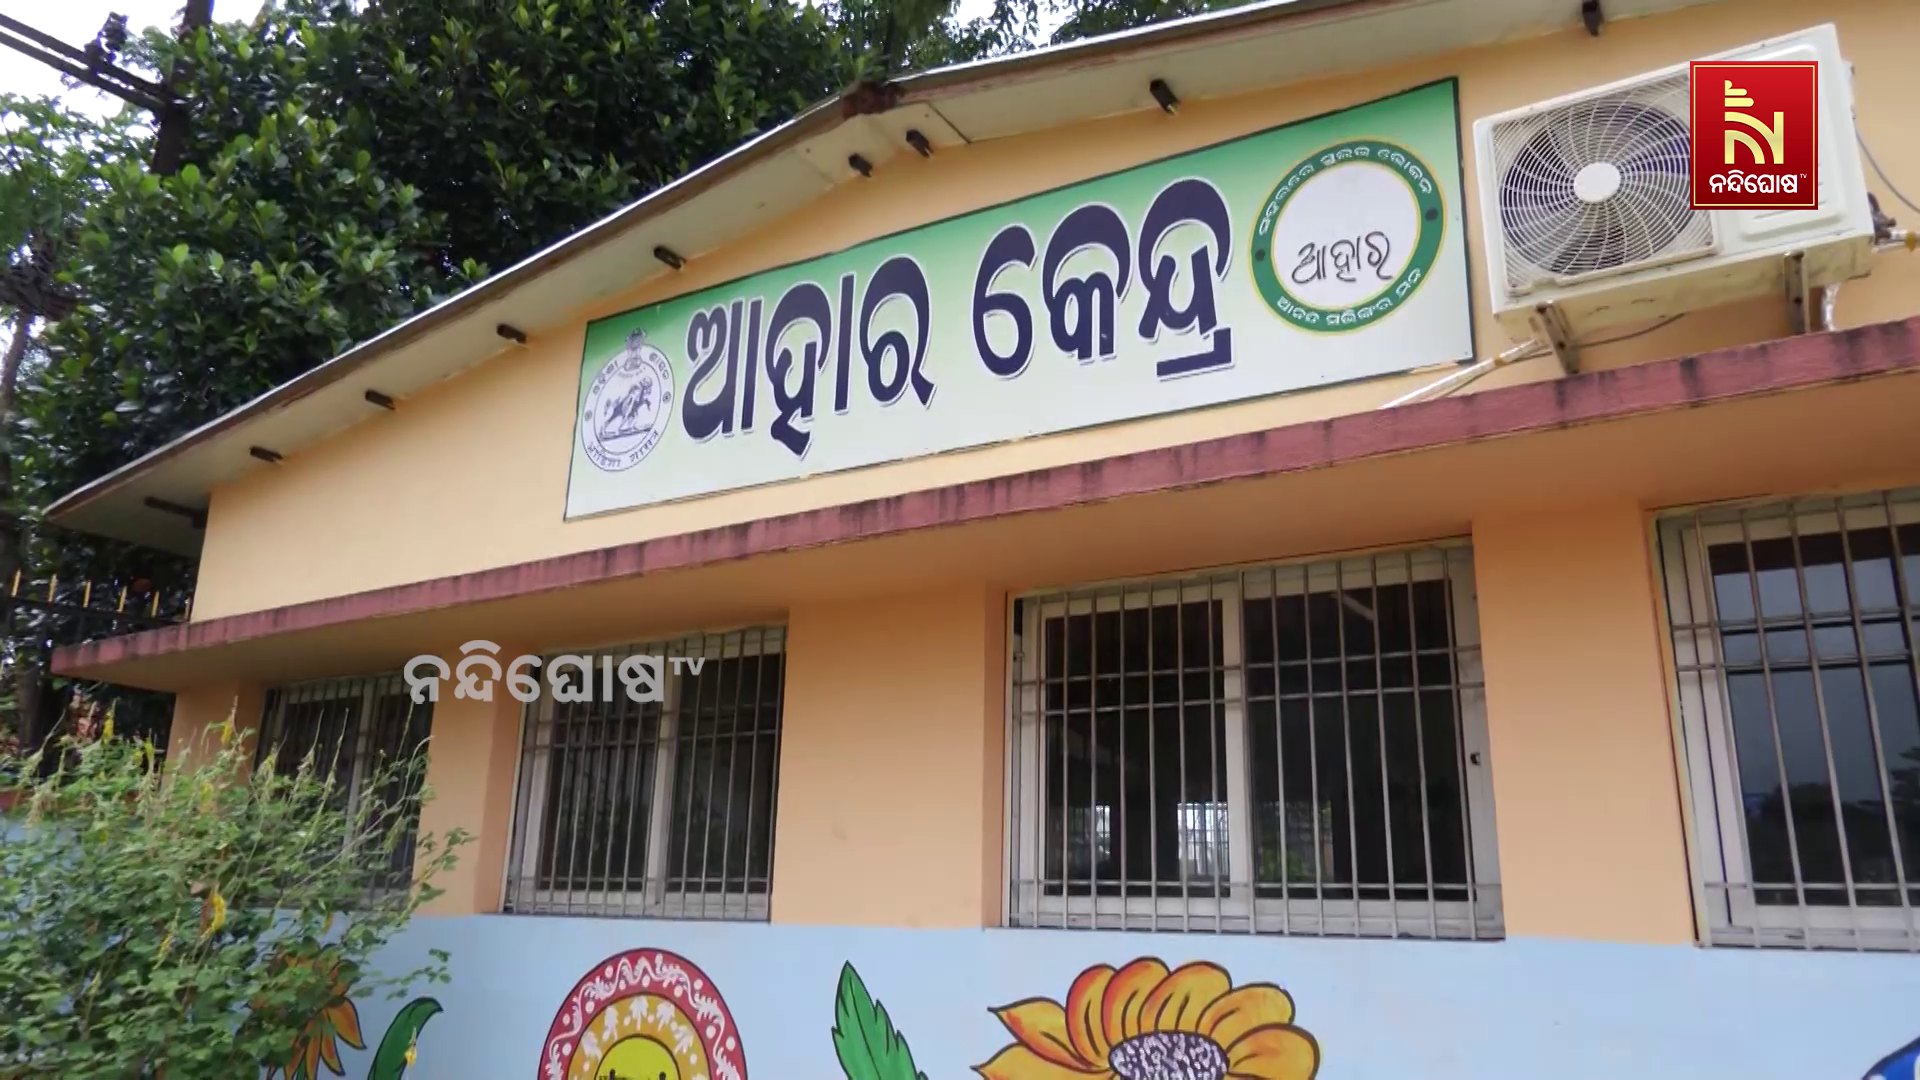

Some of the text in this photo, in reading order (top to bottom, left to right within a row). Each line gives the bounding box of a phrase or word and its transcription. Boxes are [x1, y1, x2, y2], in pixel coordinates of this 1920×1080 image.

[681, 175, 1236, 462] ଆହାର କେନ୍ଦ୍ର
[1291, 230, 1394, 285] ଆହାର
